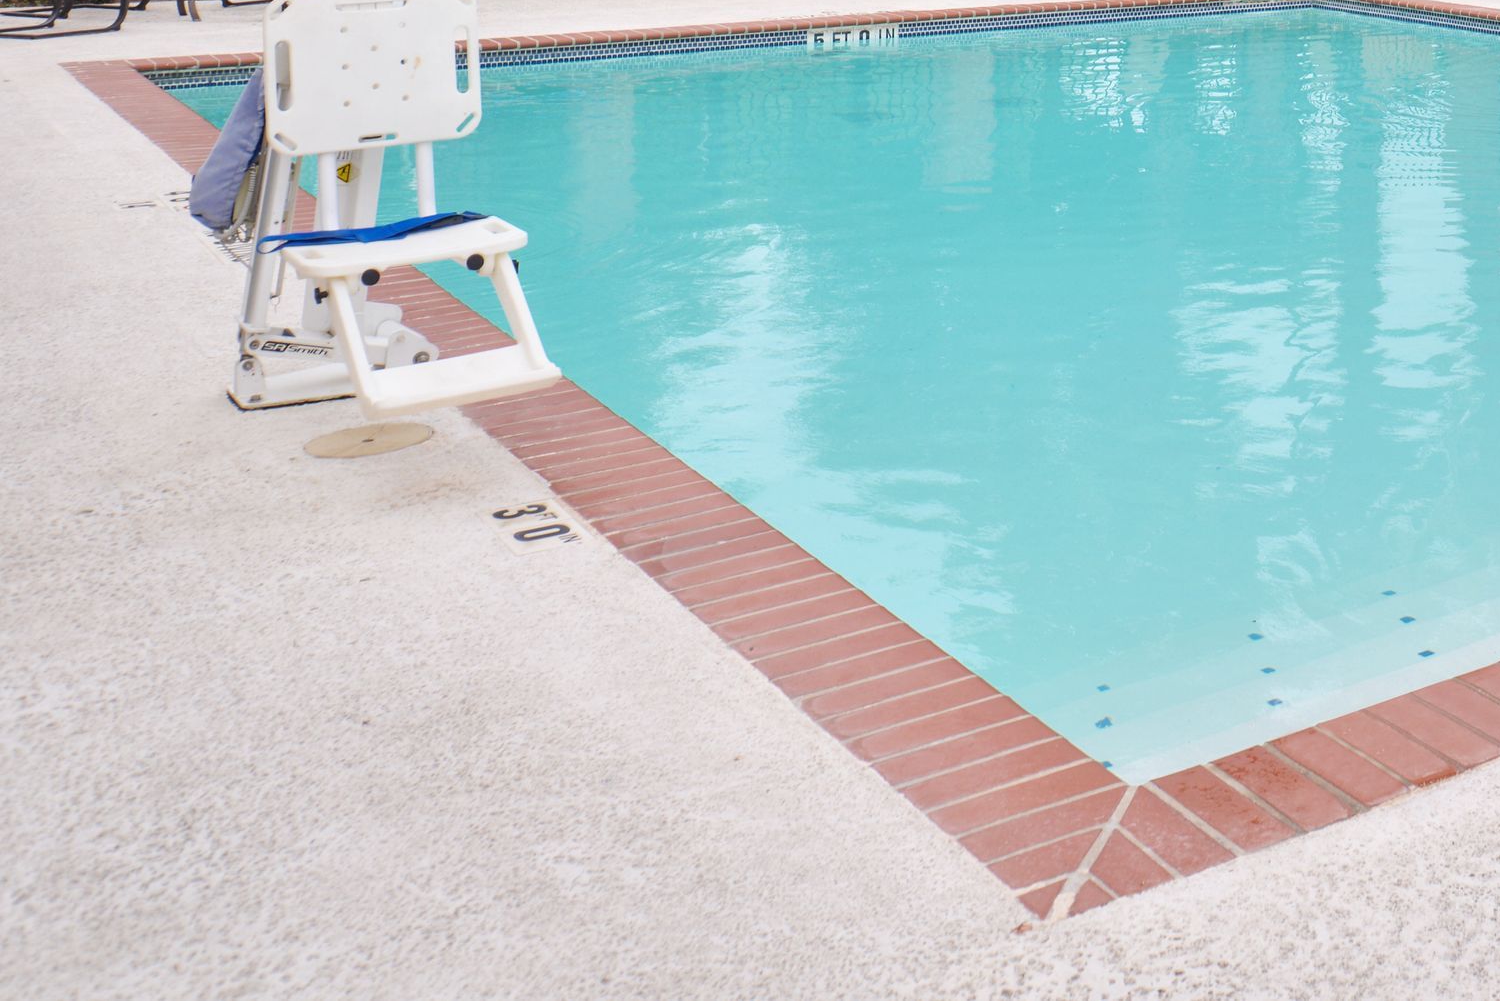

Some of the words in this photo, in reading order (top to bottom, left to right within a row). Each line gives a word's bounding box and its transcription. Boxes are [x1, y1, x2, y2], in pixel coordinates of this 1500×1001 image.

[814, 33, 824, 43] 5
[833, 31, 851, 42] FT
[879, 28, 894, 39] IN
[288, 344, 328, 356] Smith
[492, 504, 547, 519] 3
[514, 524, 570, 542] 0
